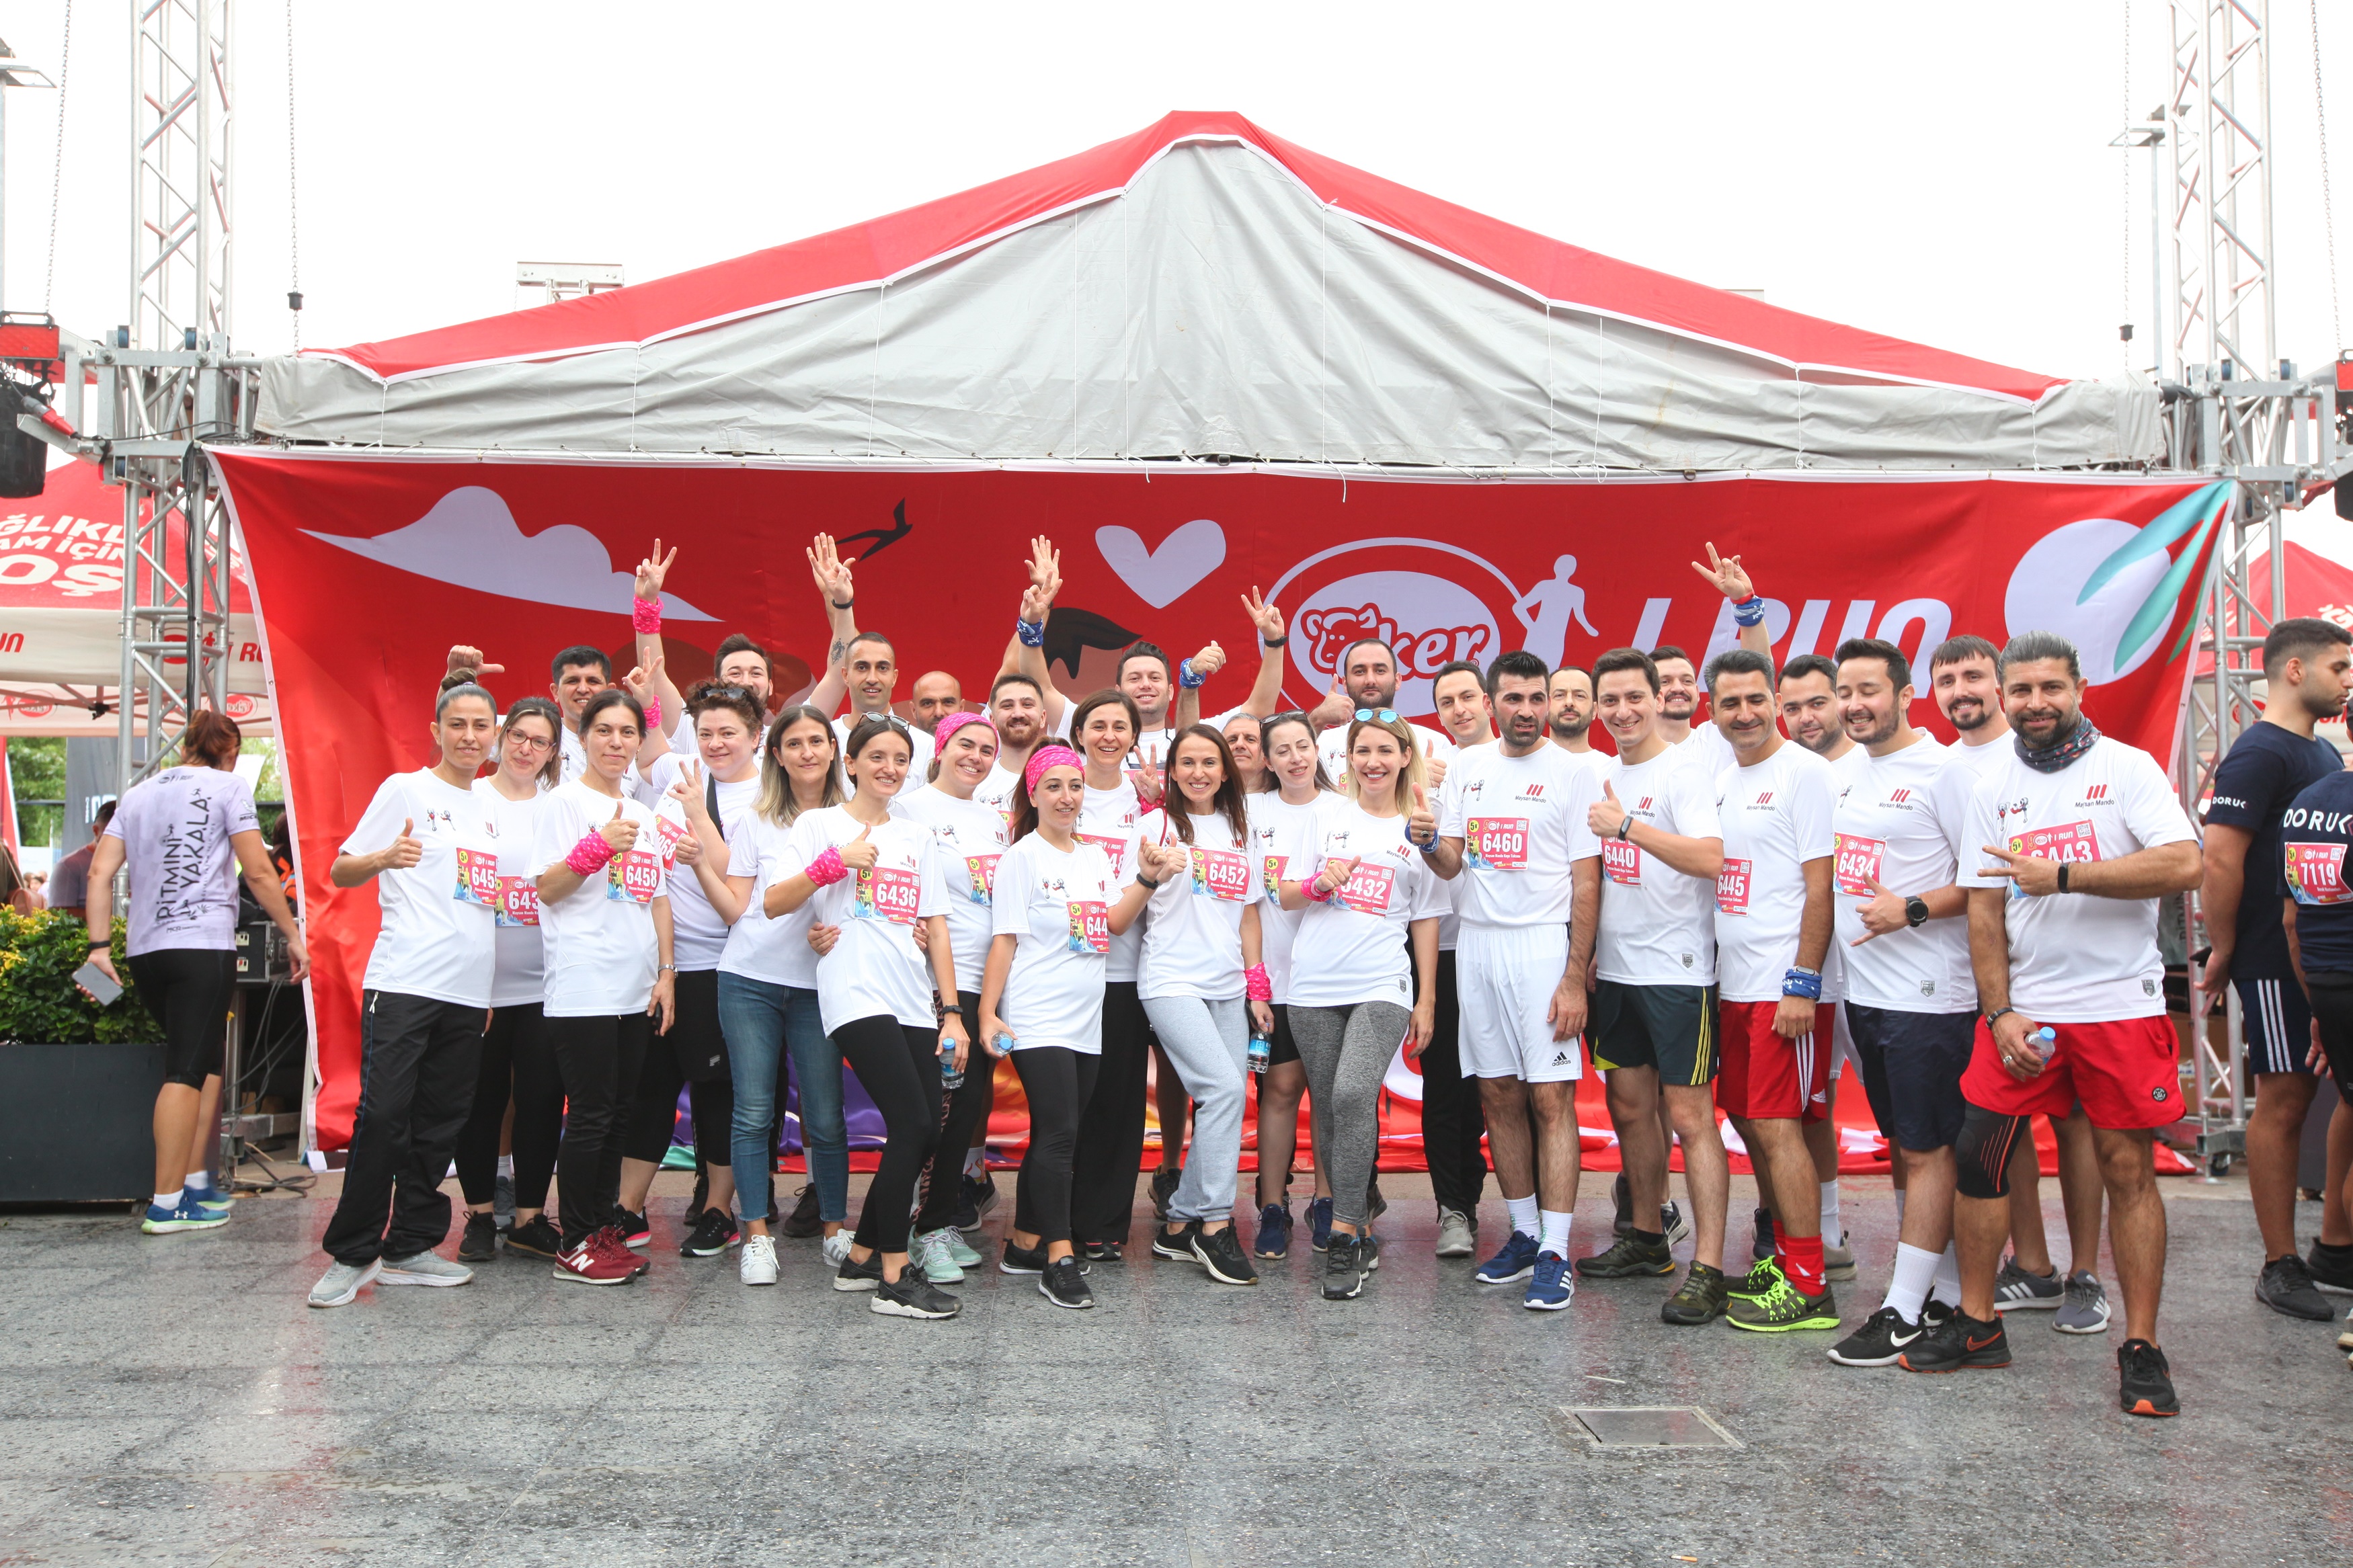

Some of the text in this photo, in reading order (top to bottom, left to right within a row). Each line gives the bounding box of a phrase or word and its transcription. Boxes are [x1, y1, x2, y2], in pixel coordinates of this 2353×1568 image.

[0, 513, 125, 544] ĞLIKL
[1482, 833, 1523, 853] 6460
[2013, 841, 2022, 852] 5K
[2059, 831, 2073, 841] RUN
[1386, 850, 1412, 867] Maysan Mando
[1605, 845, 1635, 868] 6440
[1839, 852, 1876, 877] 6434
[472, 866, 497, 889] 645
[626, 865, 657, 888] 6458
[862, 869, 871, 878] 5K
[986, 870, 994, 889] 6
[1209, 863, 1246, 886] 6452
[2301, 863, 2337, 886] 7119
[877, 883, 917, 908] 6436
[1341, 876, 1387, 900] 6432
[1717, 874, 1745, 897] 6445
[509, 891, 538, 910] 643
[1072, 905, 1080, 914] 5K
[1086, 916, 1109, 936] 644
